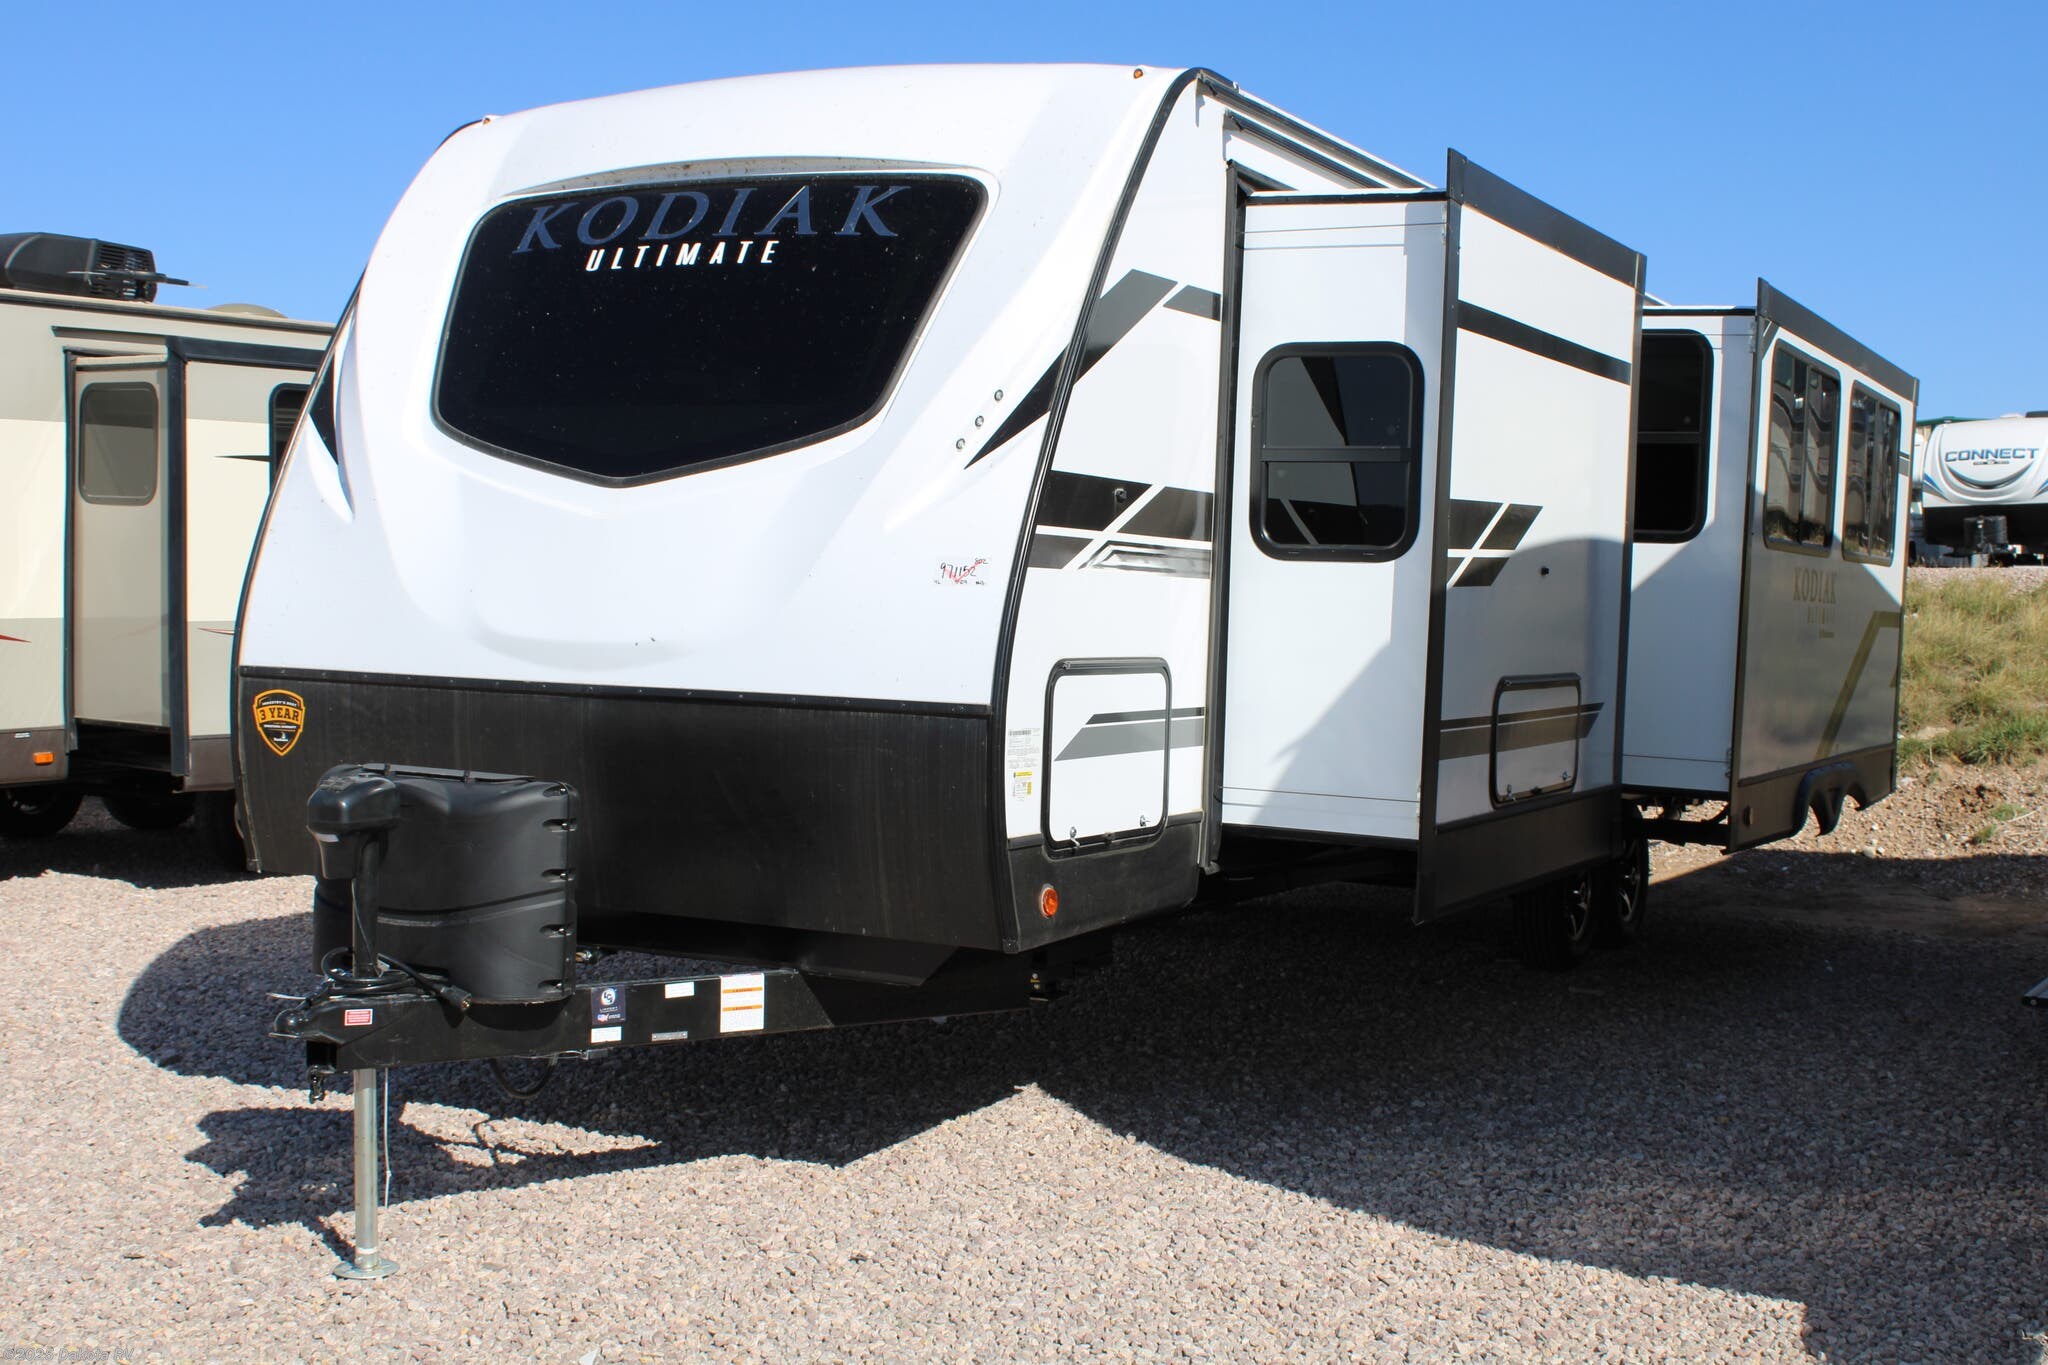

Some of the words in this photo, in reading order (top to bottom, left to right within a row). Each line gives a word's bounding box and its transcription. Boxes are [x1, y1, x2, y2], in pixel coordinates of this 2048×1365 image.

[512, 184, 911, 255] KODIAK
[585, 240, 780, 272] ULTIMATE
[1945, 448, 2039, 462] CONNECT
[1793, 567, 1837, 605] KODIAK
[260, 709, 267, 721] 3
[269, 707, 299, 722] YEAR
